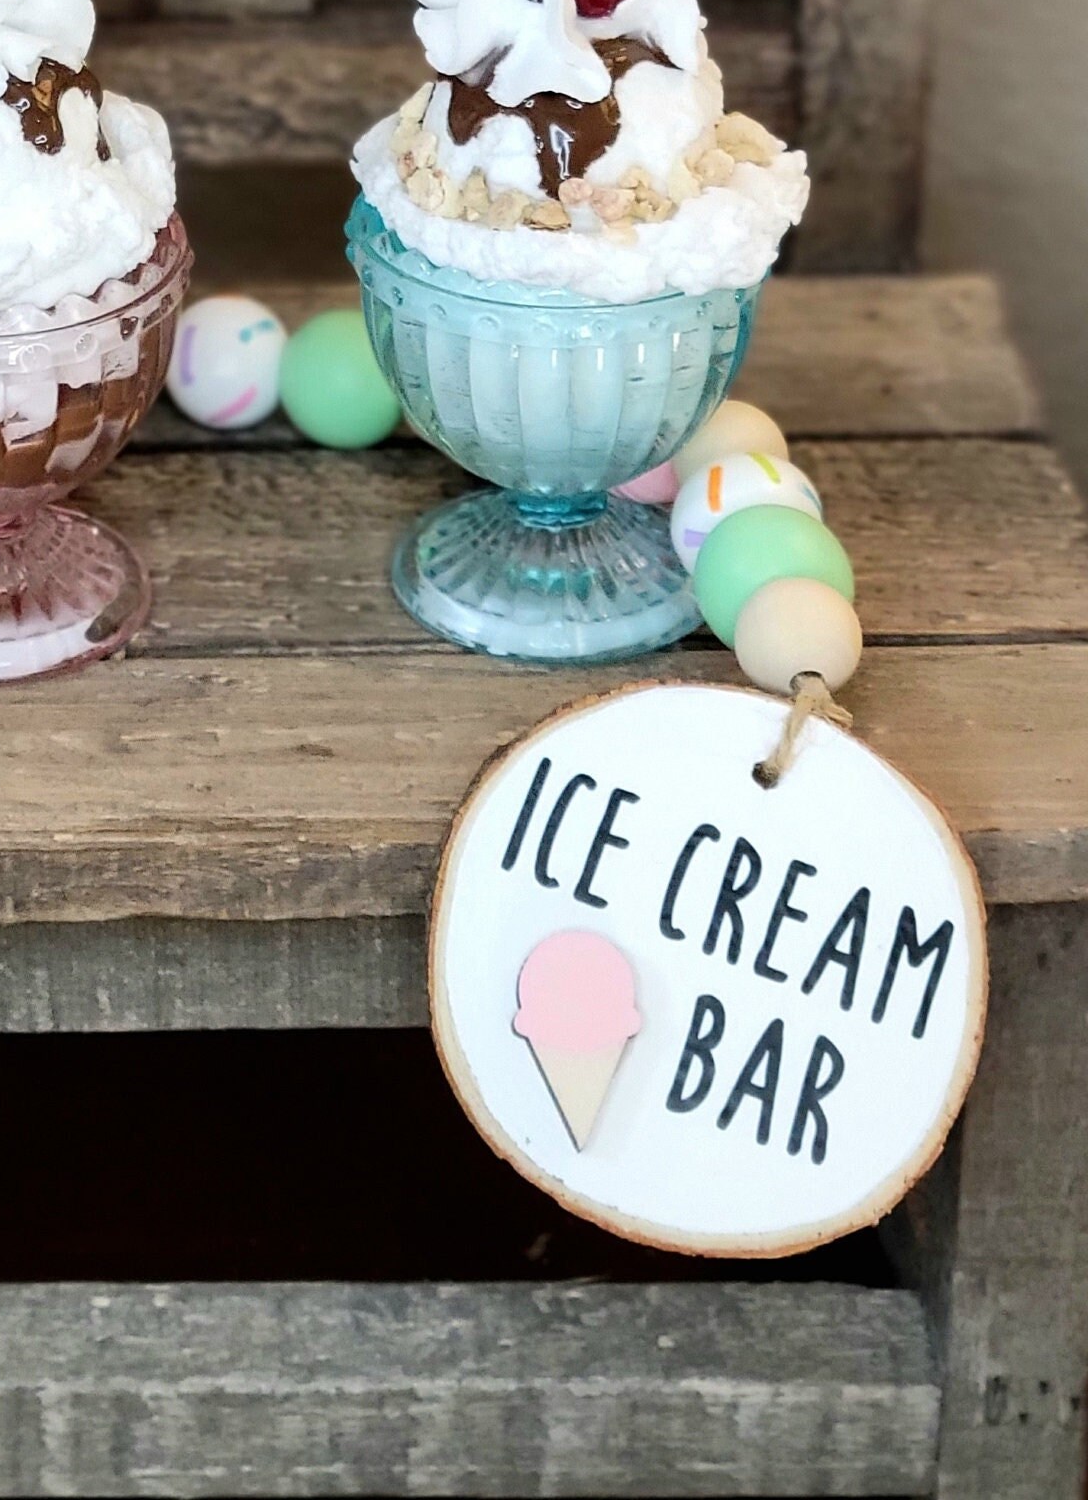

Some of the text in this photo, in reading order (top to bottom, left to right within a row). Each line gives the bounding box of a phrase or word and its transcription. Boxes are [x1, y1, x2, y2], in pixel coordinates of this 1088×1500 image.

[501, 756, 955, 1040] ICE CREAM
[665, 994, 846, 1165] BAR
